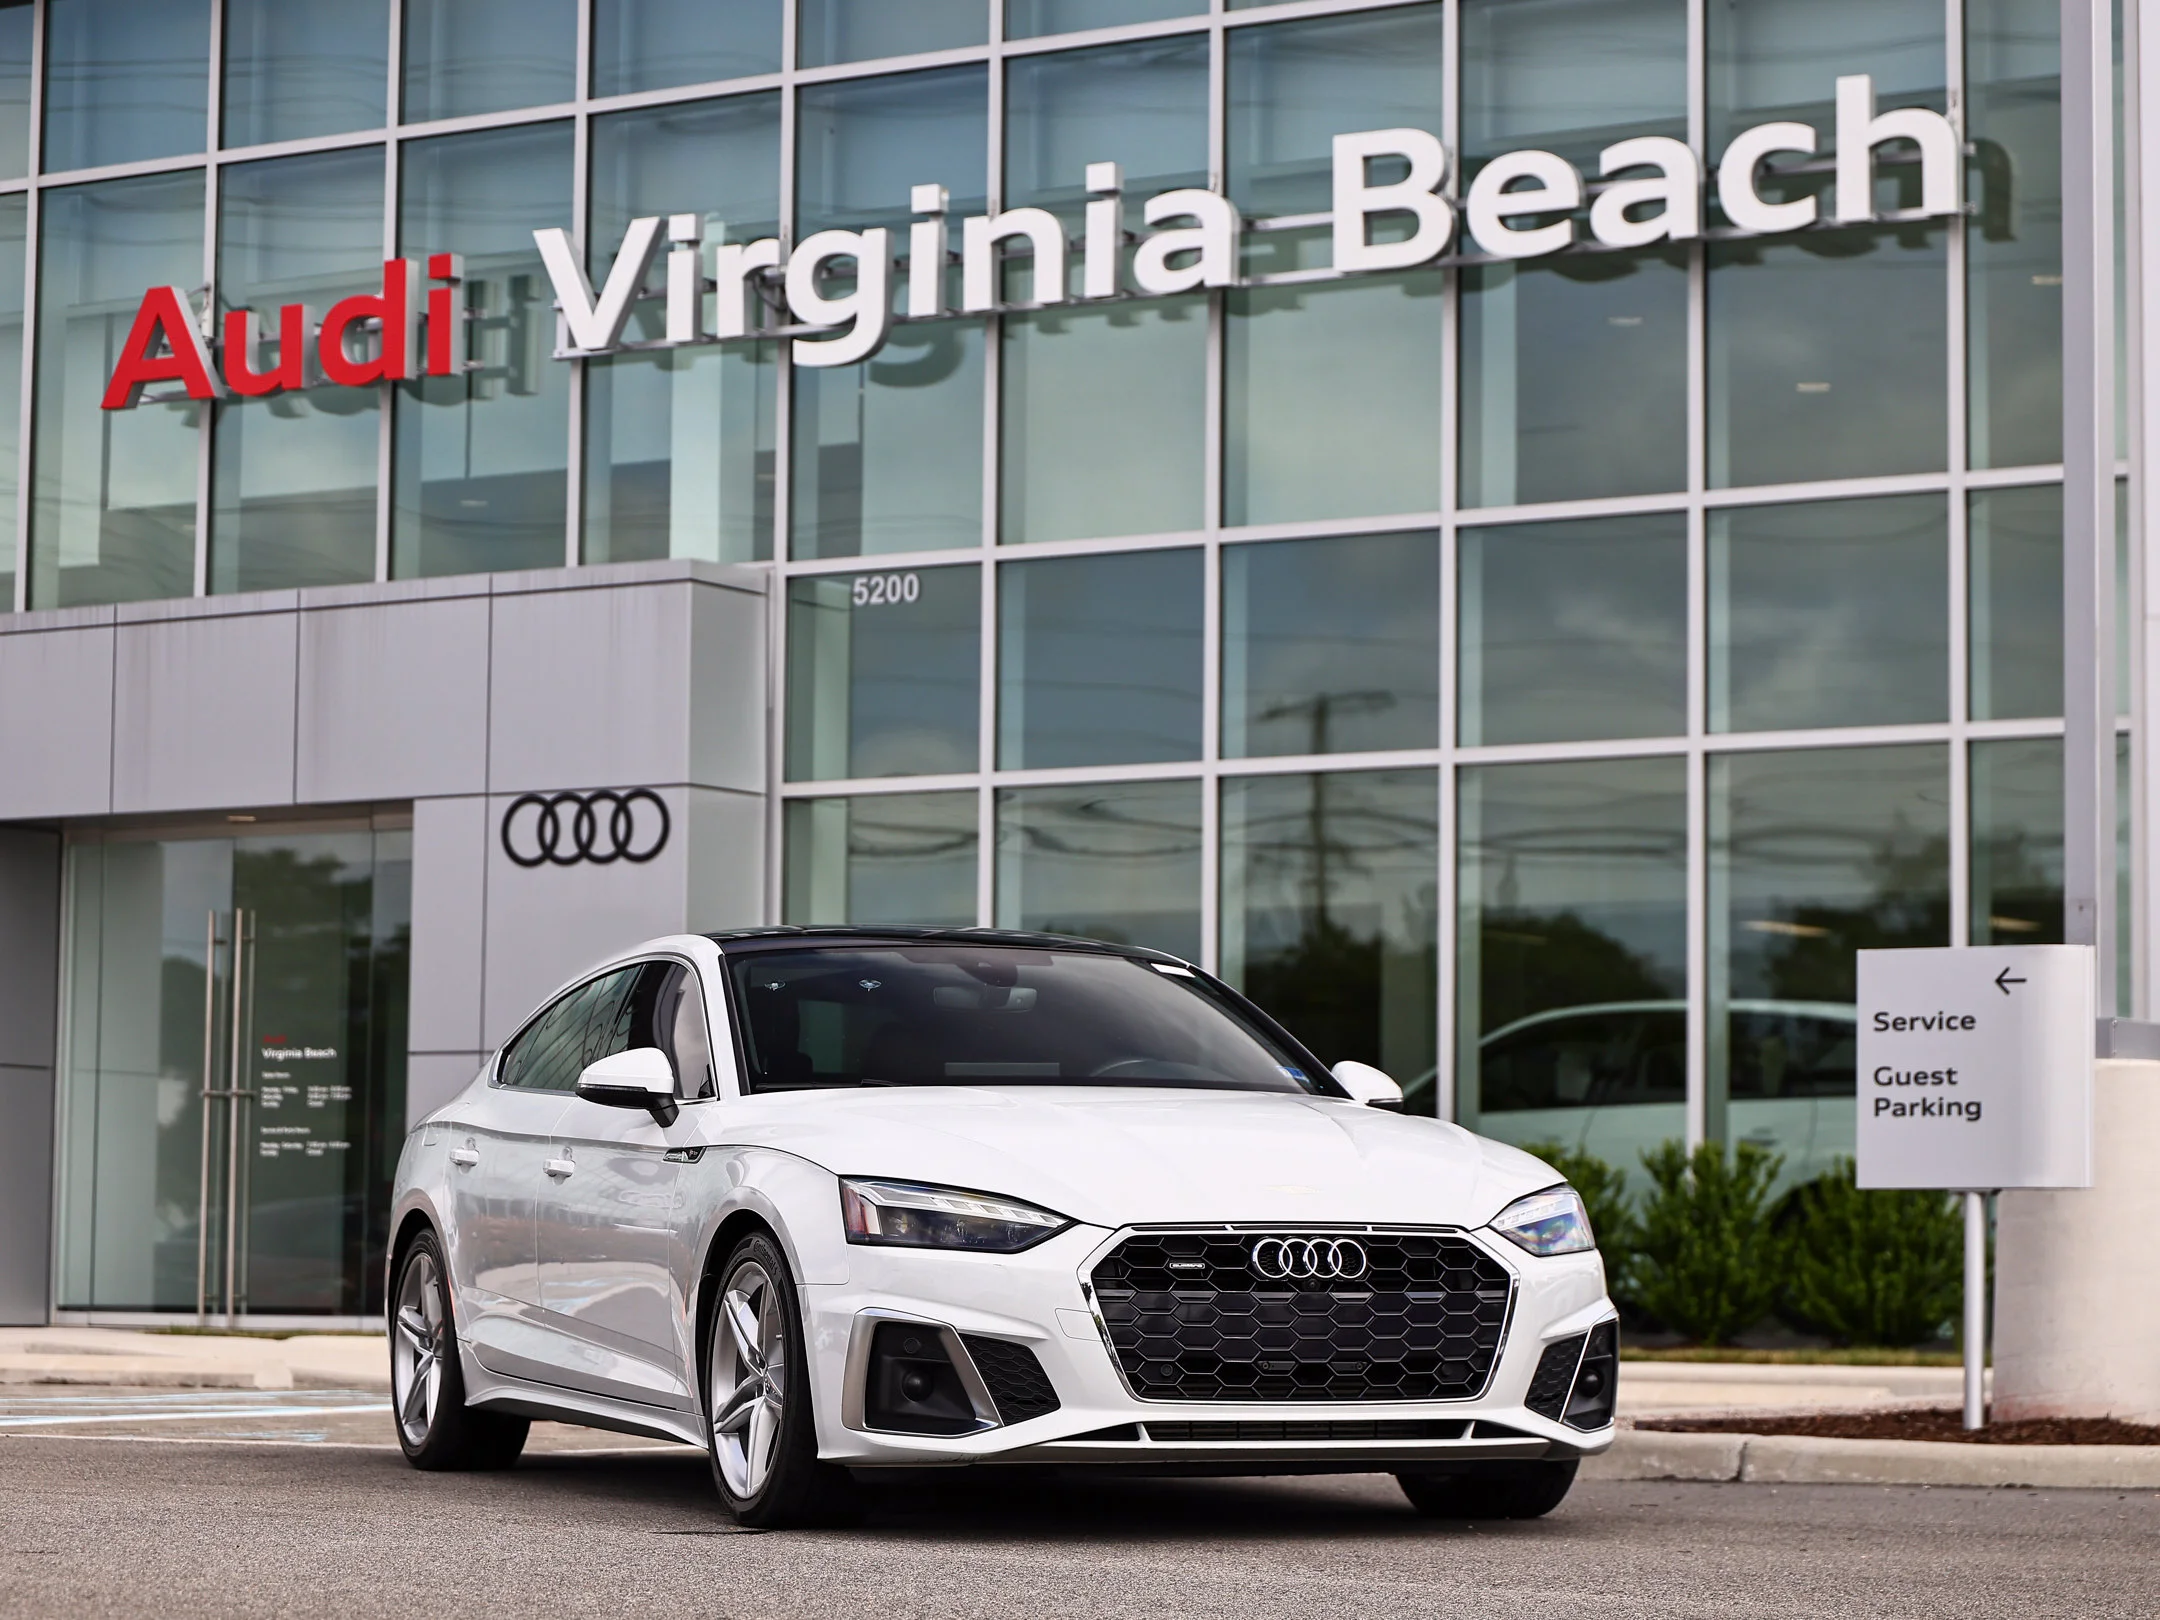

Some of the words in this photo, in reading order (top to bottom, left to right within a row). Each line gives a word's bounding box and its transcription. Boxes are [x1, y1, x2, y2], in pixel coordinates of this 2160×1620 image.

[100, 252, 464, 410] Audi
[532, 161, 1242, 368] Virginia
[1332, 73, 1962, 275] Beach
[853, 573, 920, 607] 5200
[1873, 1010, 1977, 1032] Service
[1873, 1066, 1959, 1087] Guest
[1873, 1096, 1982, 1123] Parking
